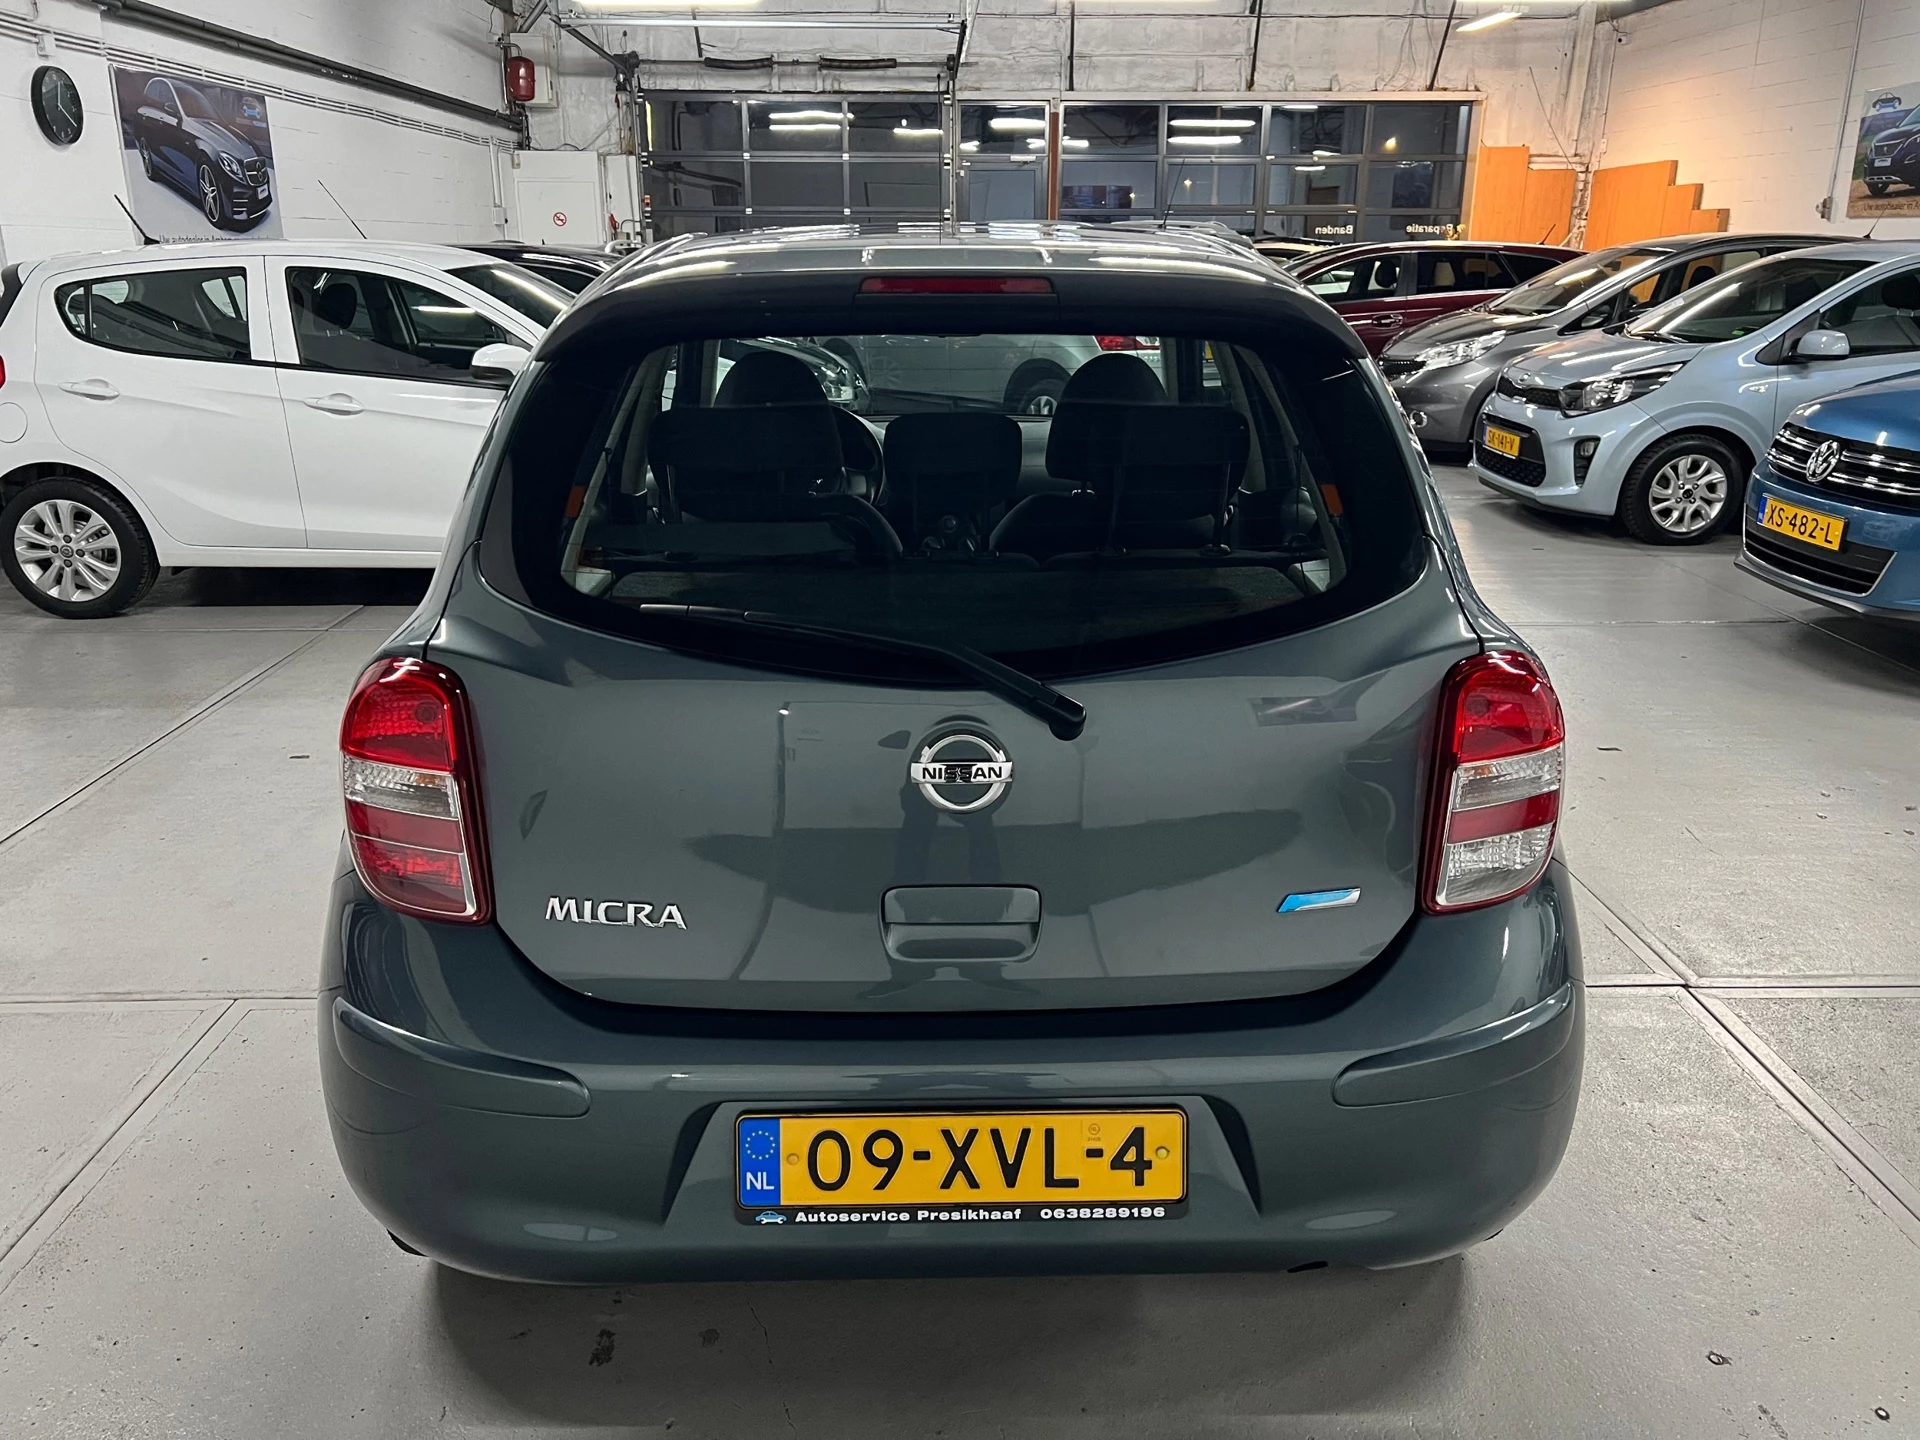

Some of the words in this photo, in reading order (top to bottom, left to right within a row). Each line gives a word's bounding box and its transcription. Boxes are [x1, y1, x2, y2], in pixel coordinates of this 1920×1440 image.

[1488, 429, 1516, 451] SK-141-V
[1767, 503, 1833, 545] XS-482-L
[922, 764, 1003, 783] NISSAN
[545, 896, 687, 930] MICRA
[746, 1171, 775, 1191] NL
[807, 1126, 1153, 1192] 09-XVL-4
[795, 1210, 910, 1223] Autoservice
[917, 1208, 1022, 1222] Presikhaaf
[1040, 1207, 1166, 1220] 0638289196
